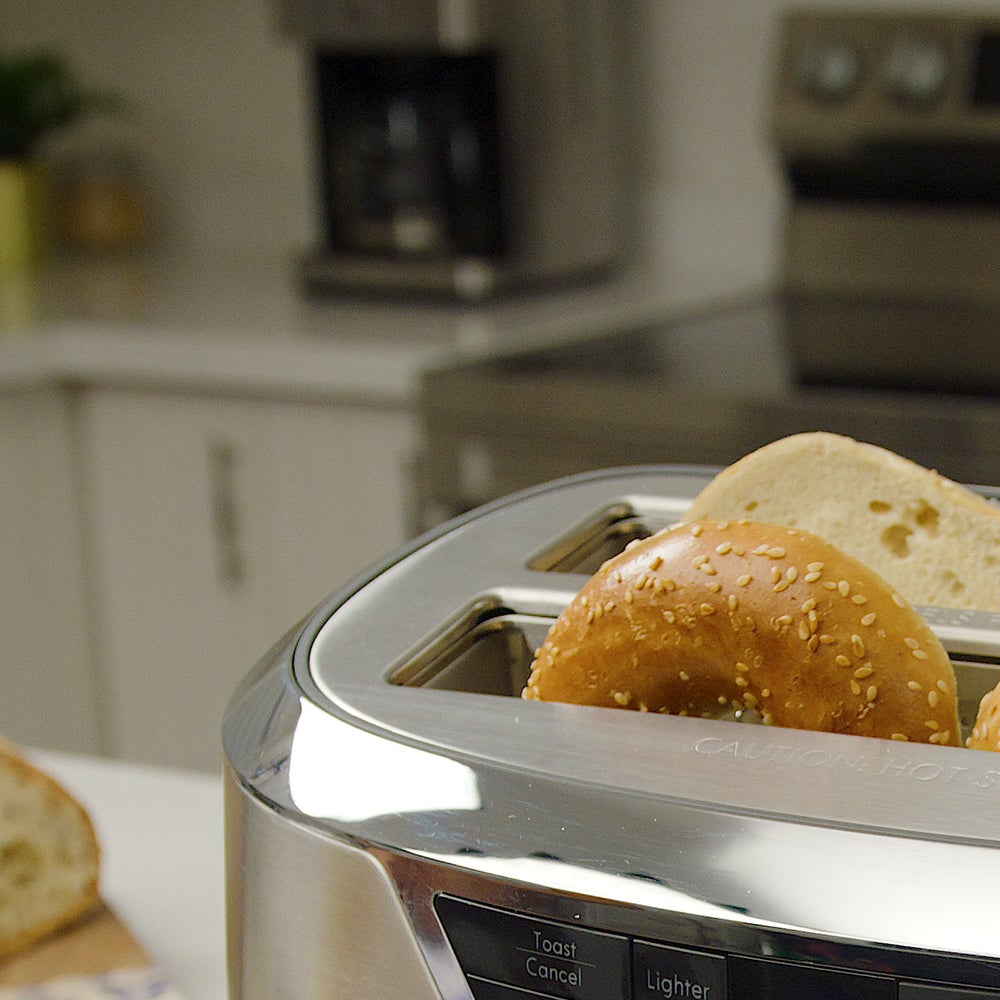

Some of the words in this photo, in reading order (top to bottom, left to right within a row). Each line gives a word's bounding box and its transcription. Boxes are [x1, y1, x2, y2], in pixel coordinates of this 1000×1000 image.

[875, 757, 969, 786] HOT
[532, 930, 577, 959] Toast
[525, 956, 583, 988] Cancel
